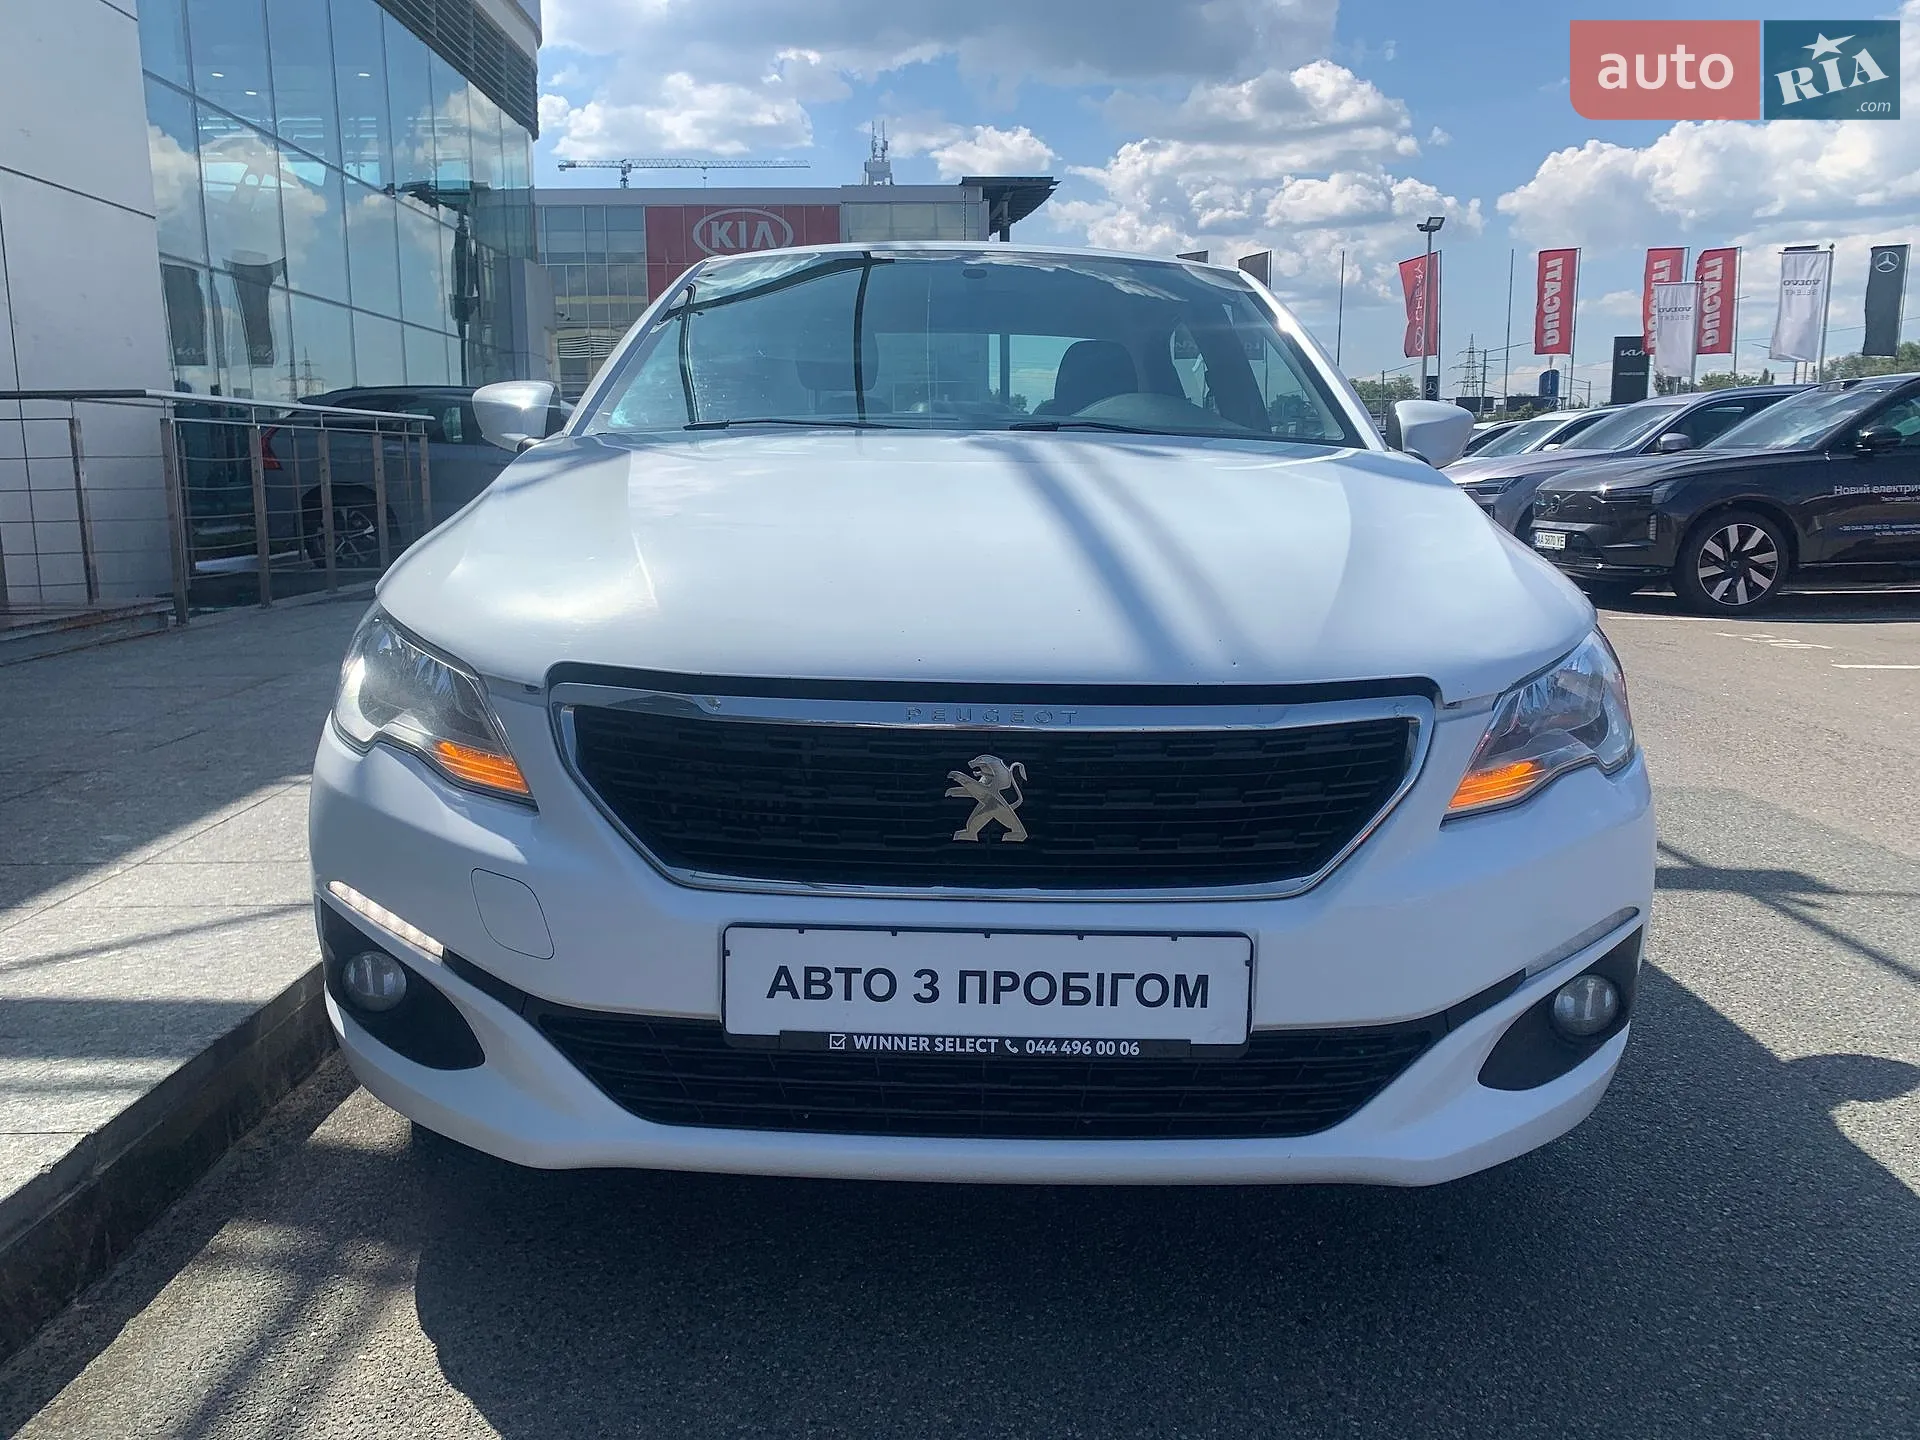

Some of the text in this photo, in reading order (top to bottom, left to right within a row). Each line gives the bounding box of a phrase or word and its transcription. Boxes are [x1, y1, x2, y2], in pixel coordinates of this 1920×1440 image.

[710, 221, 777, 248] KIA
[1834, 484, 1870, 495] Новий
[903, 706, 1078, 725] PEUGEOT
[766, 965, 898, 1002] АВТО
[958, 969, 1209, 1009] ПРОБІГОМ
[853, 1035, 1140, 1056] WINNER SELECT 044 496 00 06
